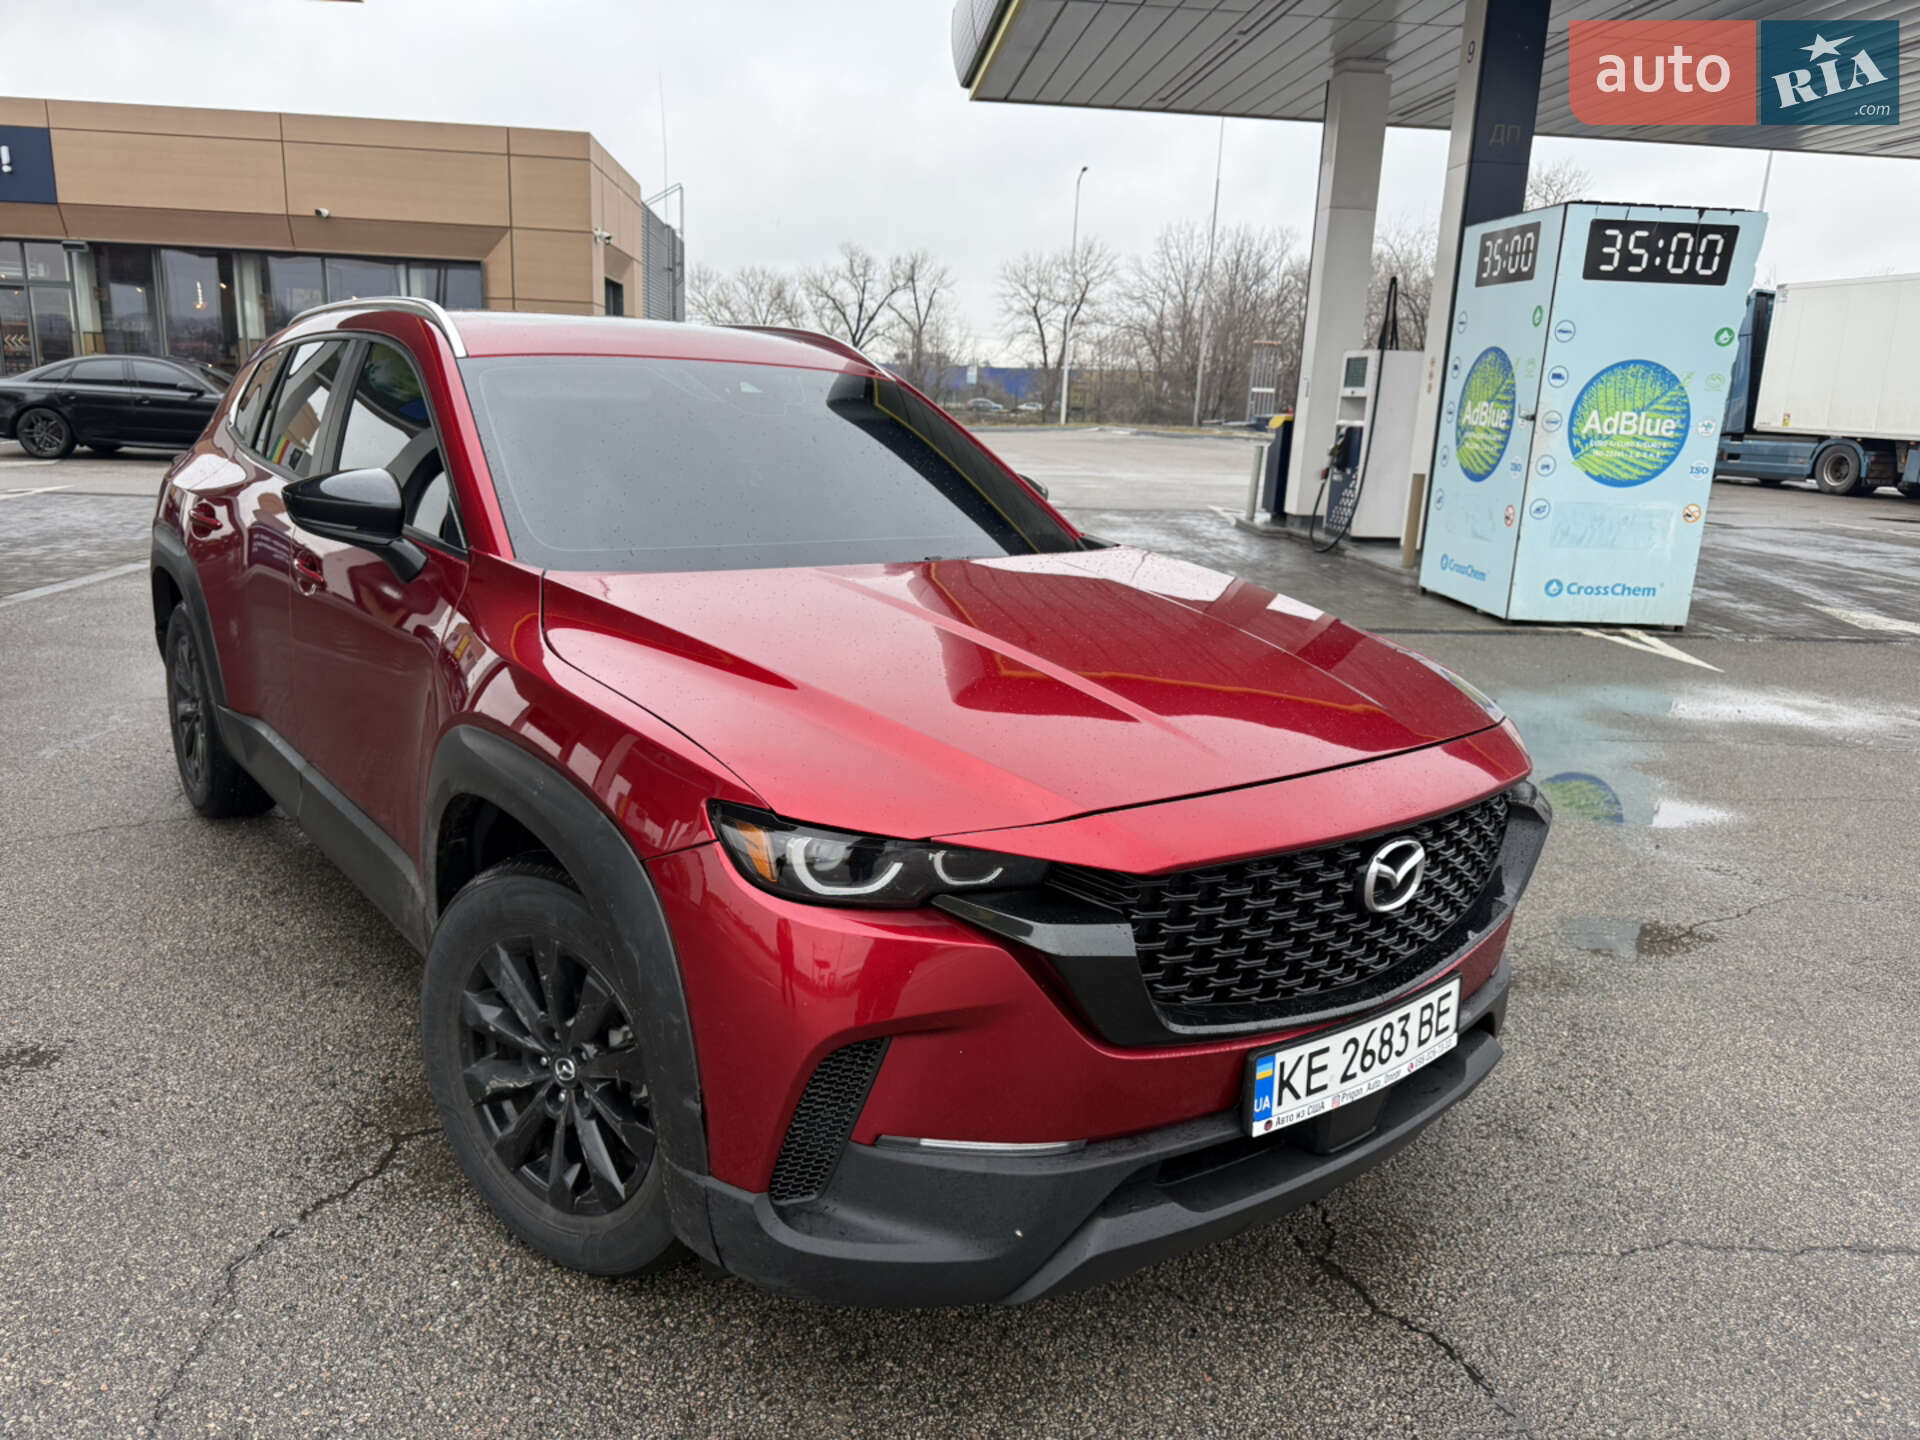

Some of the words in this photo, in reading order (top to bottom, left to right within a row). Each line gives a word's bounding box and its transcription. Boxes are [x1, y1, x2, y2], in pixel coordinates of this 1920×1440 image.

[1482, 231, 1535, 278] 35:00
[1599, 229, 1725, 275] 35:00
[1462, 400, 1508, 428] AdBlue
[1582, 409, 1677, 437] AdBlue
[1689, 466, 1709, 474] ISO
[1449, 558, 1487, 582] CrossChem
[1566, 582, 1657, 598] CrossChem
[1277, 1046, 1330, 1107] KE
[1340, 1012, 1411, 1084] 2683
[1418, 991, 1452, 1048] BE
[1254, 1095, 1271, 1113] UA
